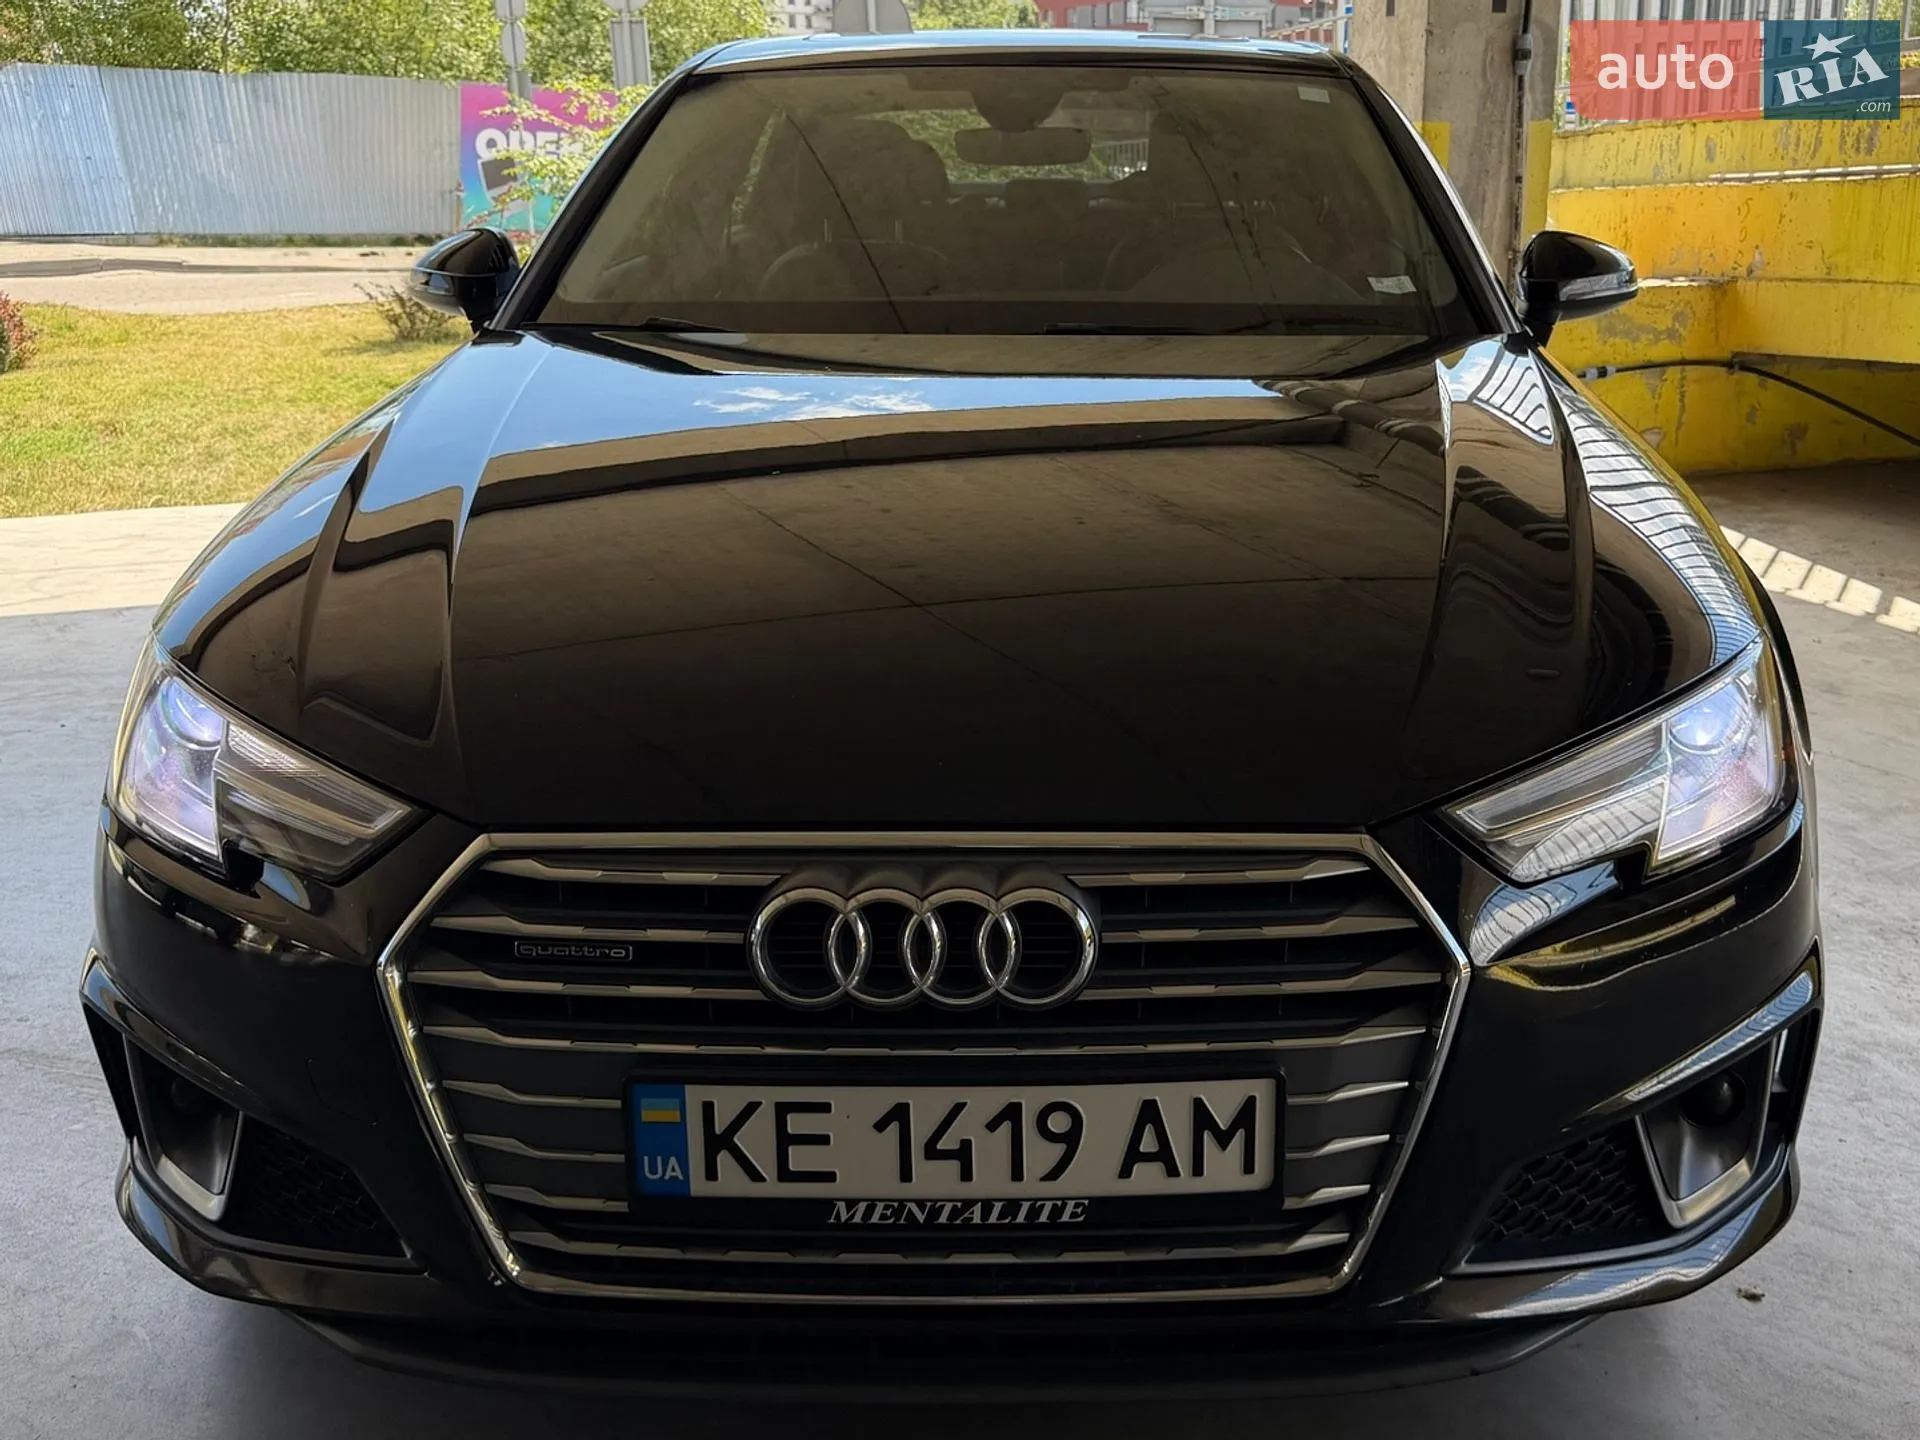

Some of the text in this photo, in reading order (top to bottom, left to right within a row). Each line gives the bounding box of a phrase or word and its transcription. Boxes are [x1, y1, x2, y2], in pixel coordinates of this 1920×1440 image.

[520, 945, 626, 958] quattro
[702, 1095, 1257, 1183] KE 1419 AM
[644, 1156, 684, 1180] UA
[827, 1199, 1090, 1225] MENTALITE
